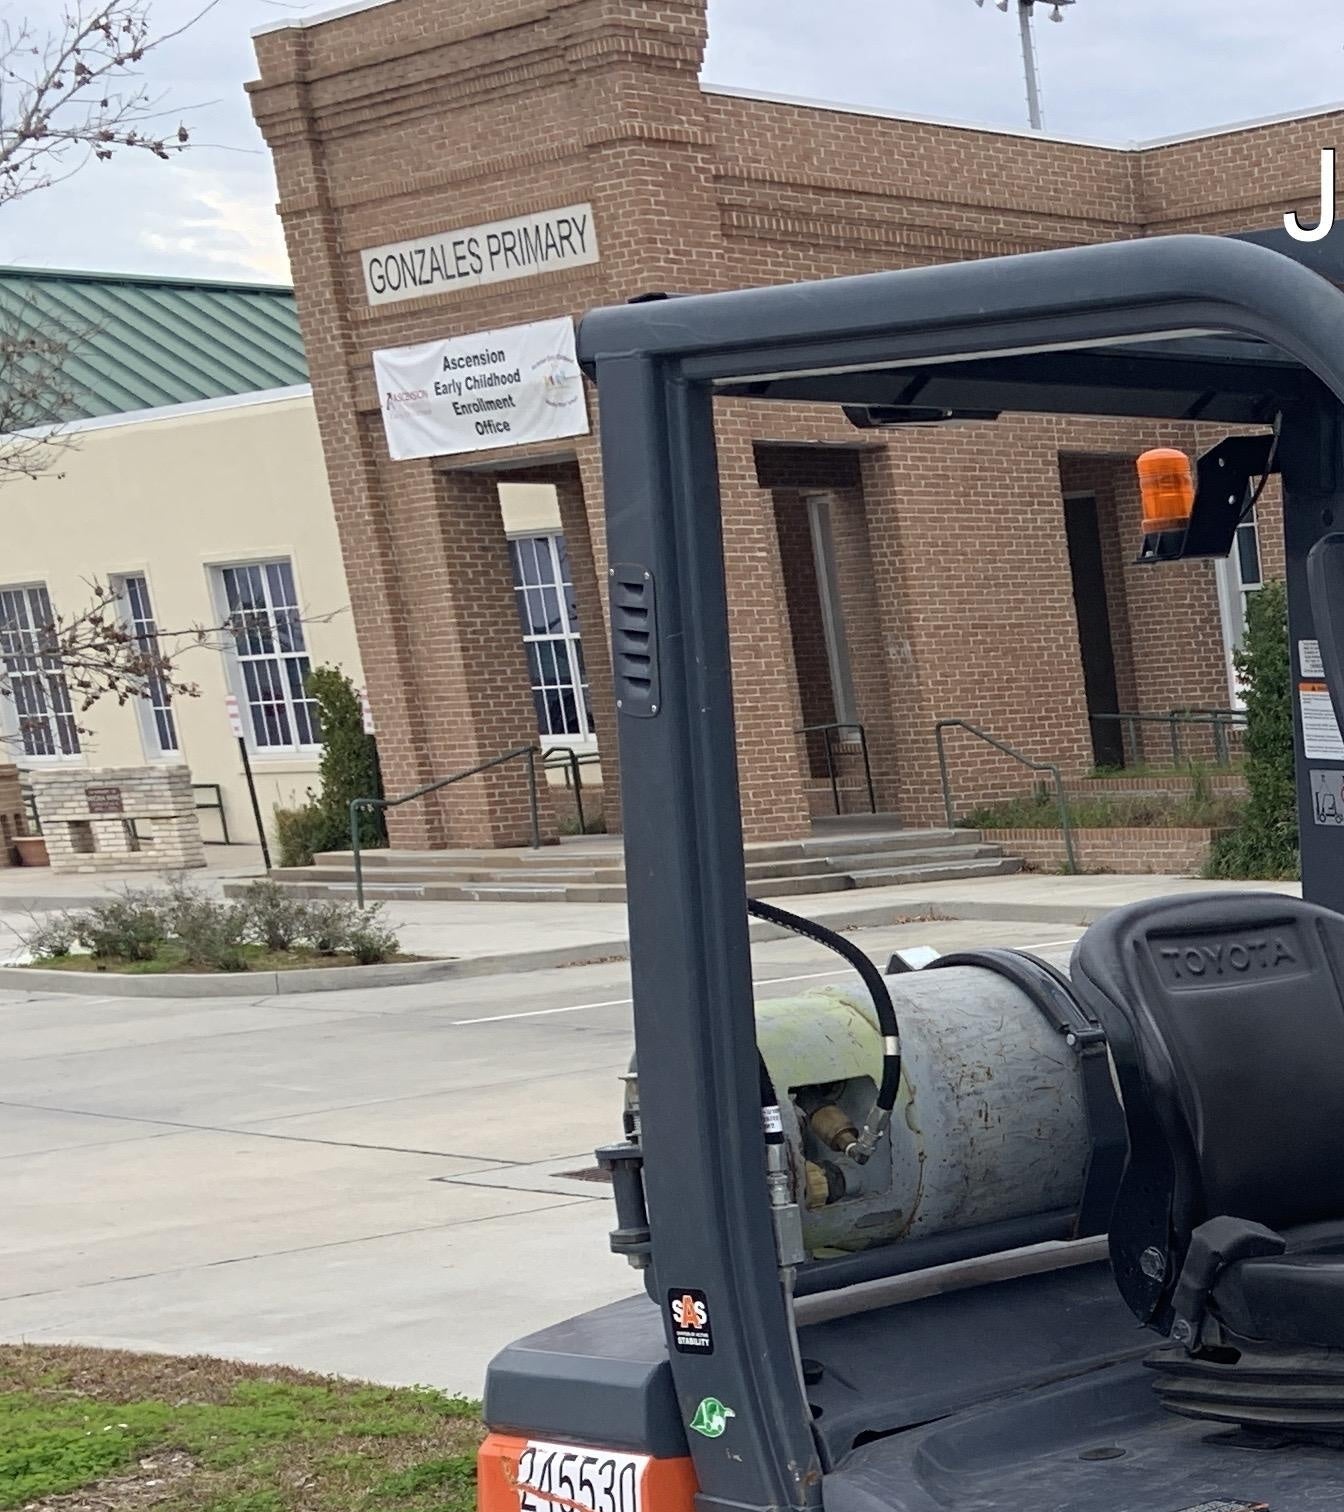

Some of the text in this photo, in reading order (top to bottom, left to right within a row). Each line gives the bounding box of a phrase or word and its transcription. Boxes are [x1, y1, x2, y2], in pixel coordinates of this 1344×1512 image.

[369, 214, 587, 294] GONZALES PRIMARY
[442, 348, 506, 371] Ascension
[434, 369, 521, 400] Early Childhood
[452, 394, 516, 416] Enrollment
[474, 419, 511, 436] Office
[1160, 938, 1297, 978] TOYOTA
[671, 1294, 708, 1330] SAS
